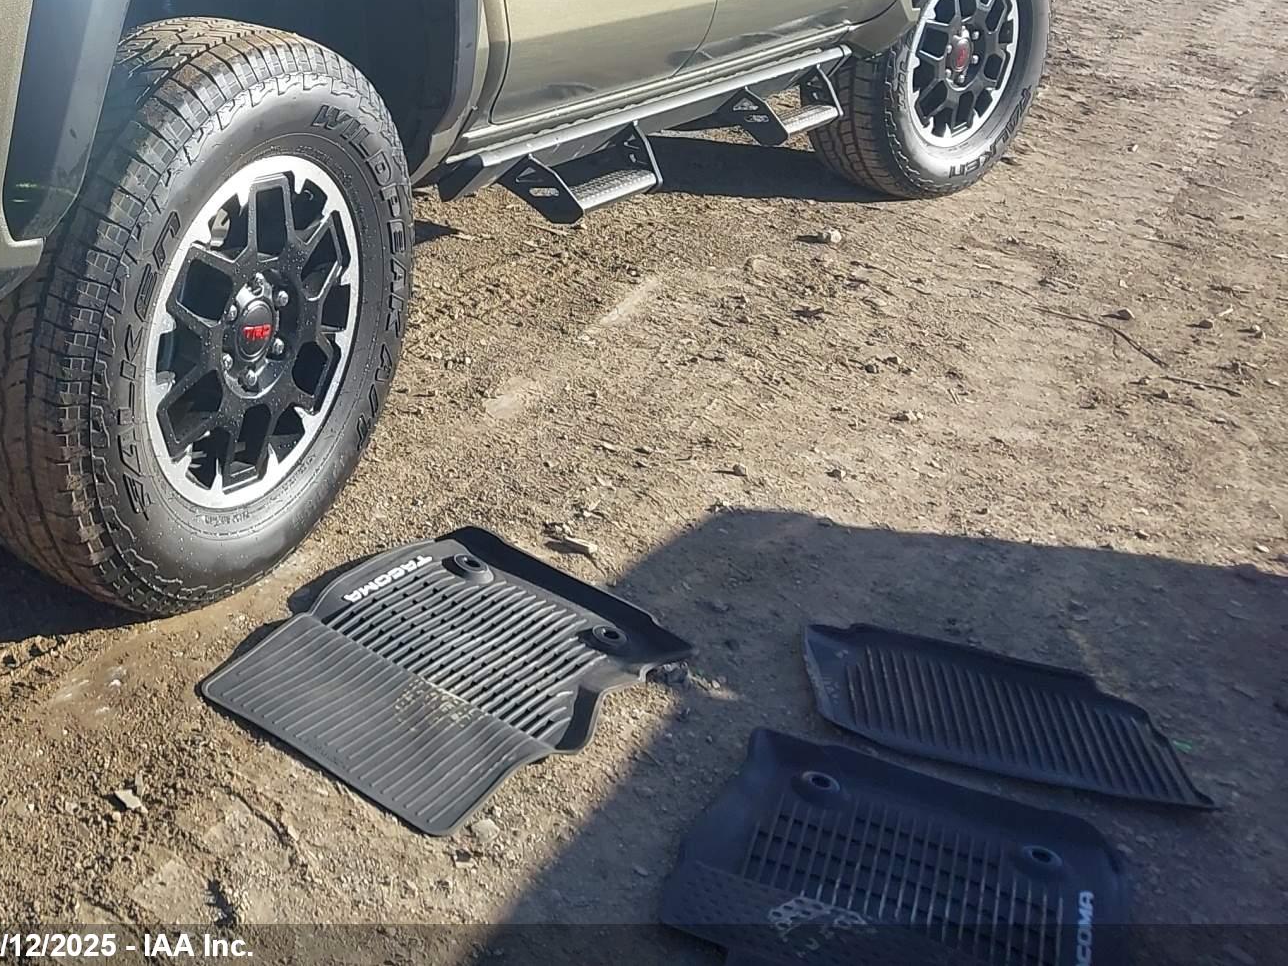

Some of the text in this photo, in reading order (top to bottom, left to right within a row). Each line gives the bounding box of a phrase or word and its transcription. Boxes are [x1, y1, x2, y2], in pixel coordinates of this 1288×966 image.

[312, 103, 408, 338] WILDPEAK
[117, 210, 181, 521] FALKEN
[342, 555, 433, 603] TACOMA
